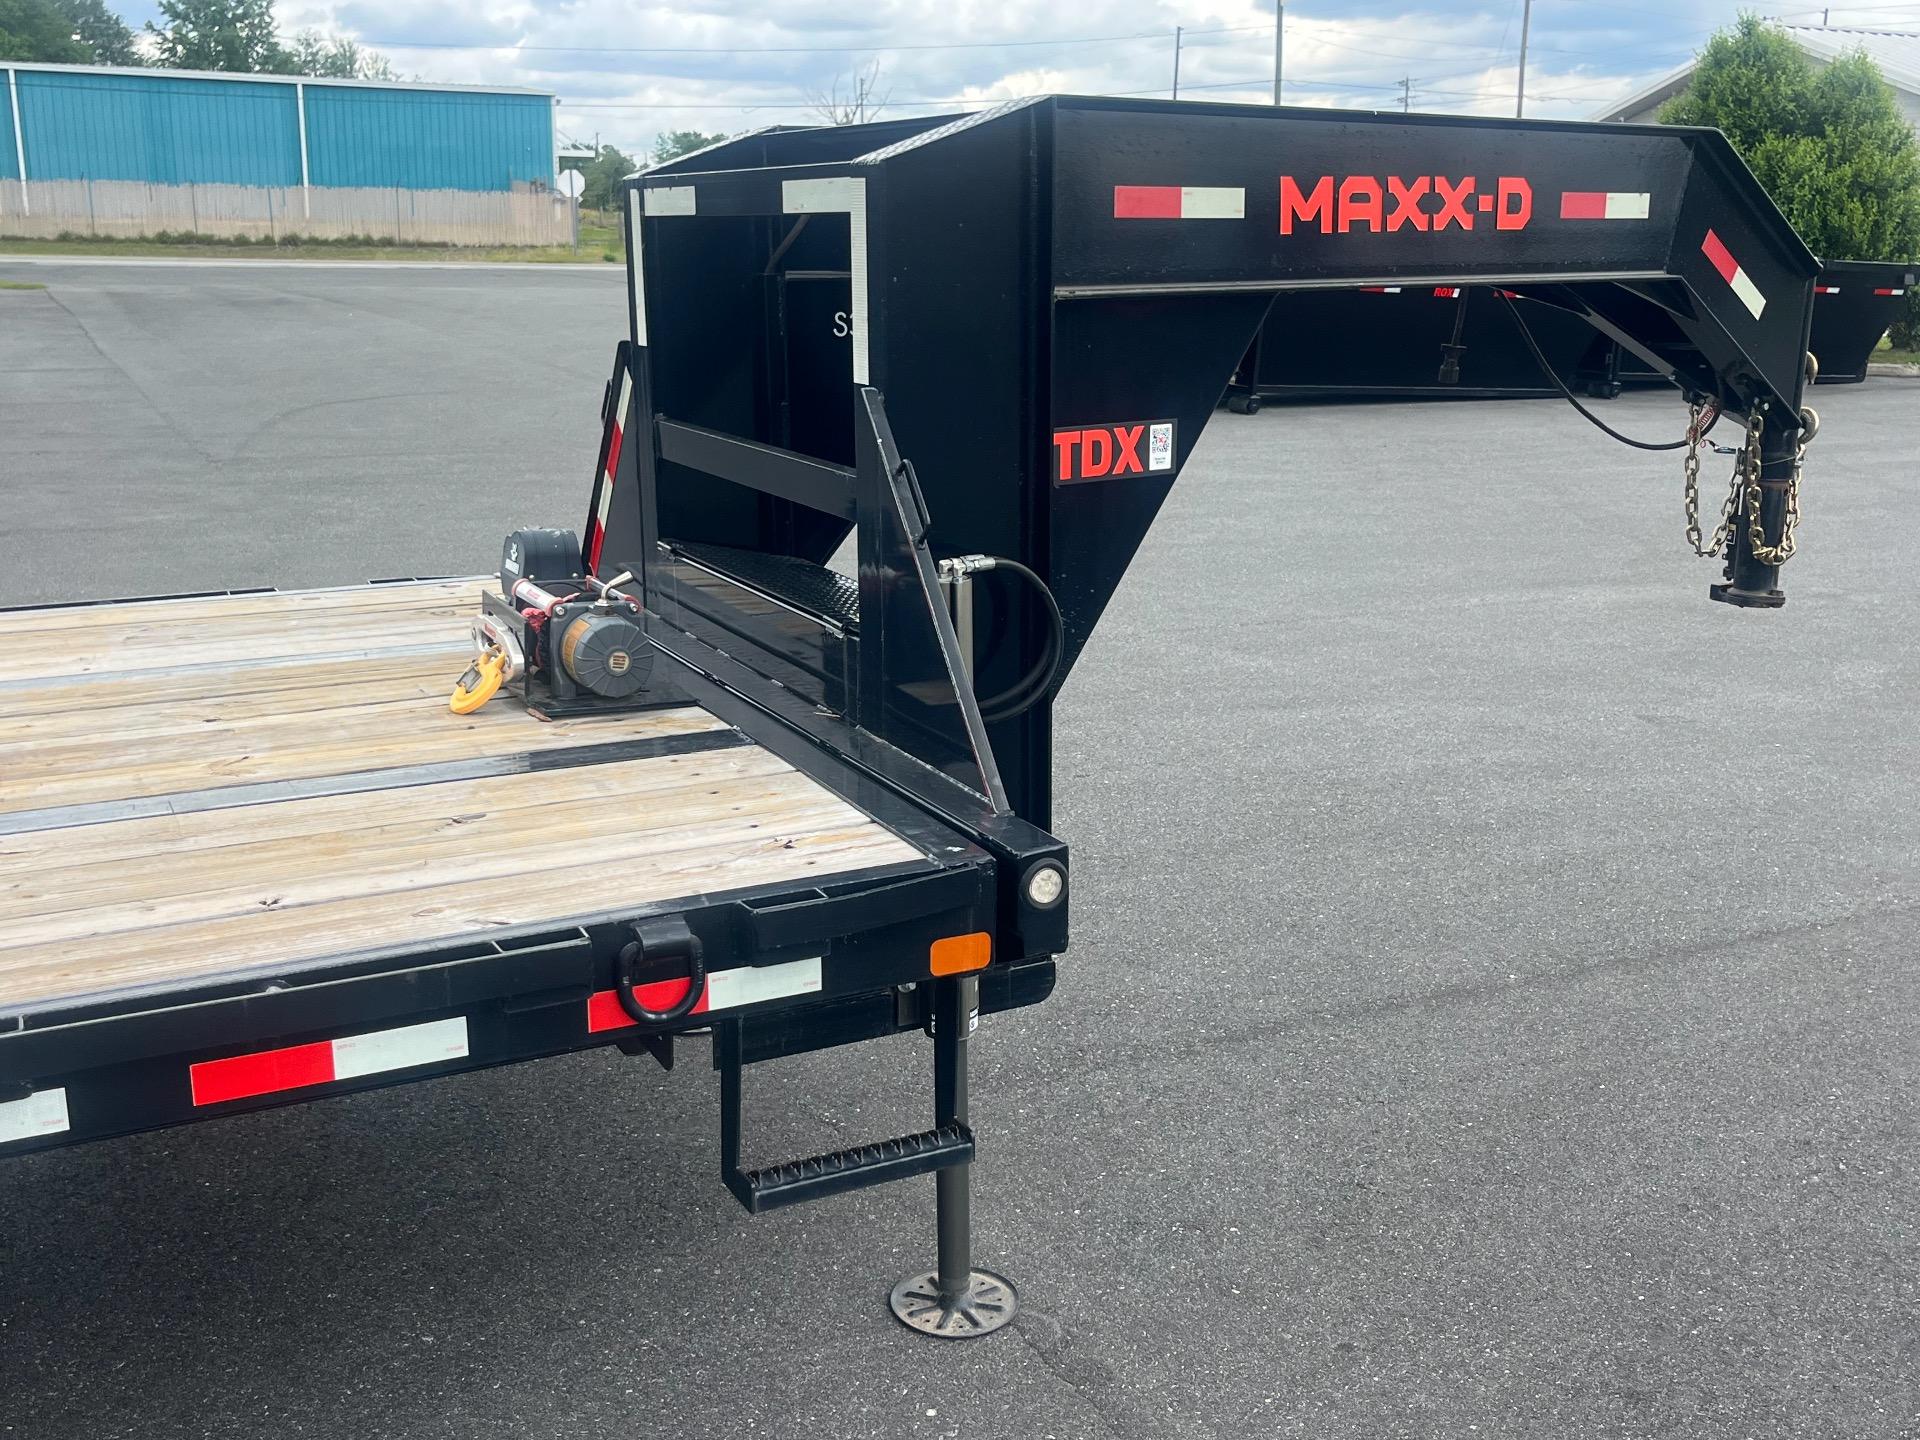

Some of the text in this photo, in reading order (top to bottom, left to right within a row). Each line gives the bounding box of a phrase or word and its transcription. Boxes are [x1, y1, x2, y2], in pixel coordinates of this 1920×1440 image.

[1279, 175, 1532, 235] MAXX-D
[833, 311, 853, 337] S
[1053, 425, 1145, 481] TDX
